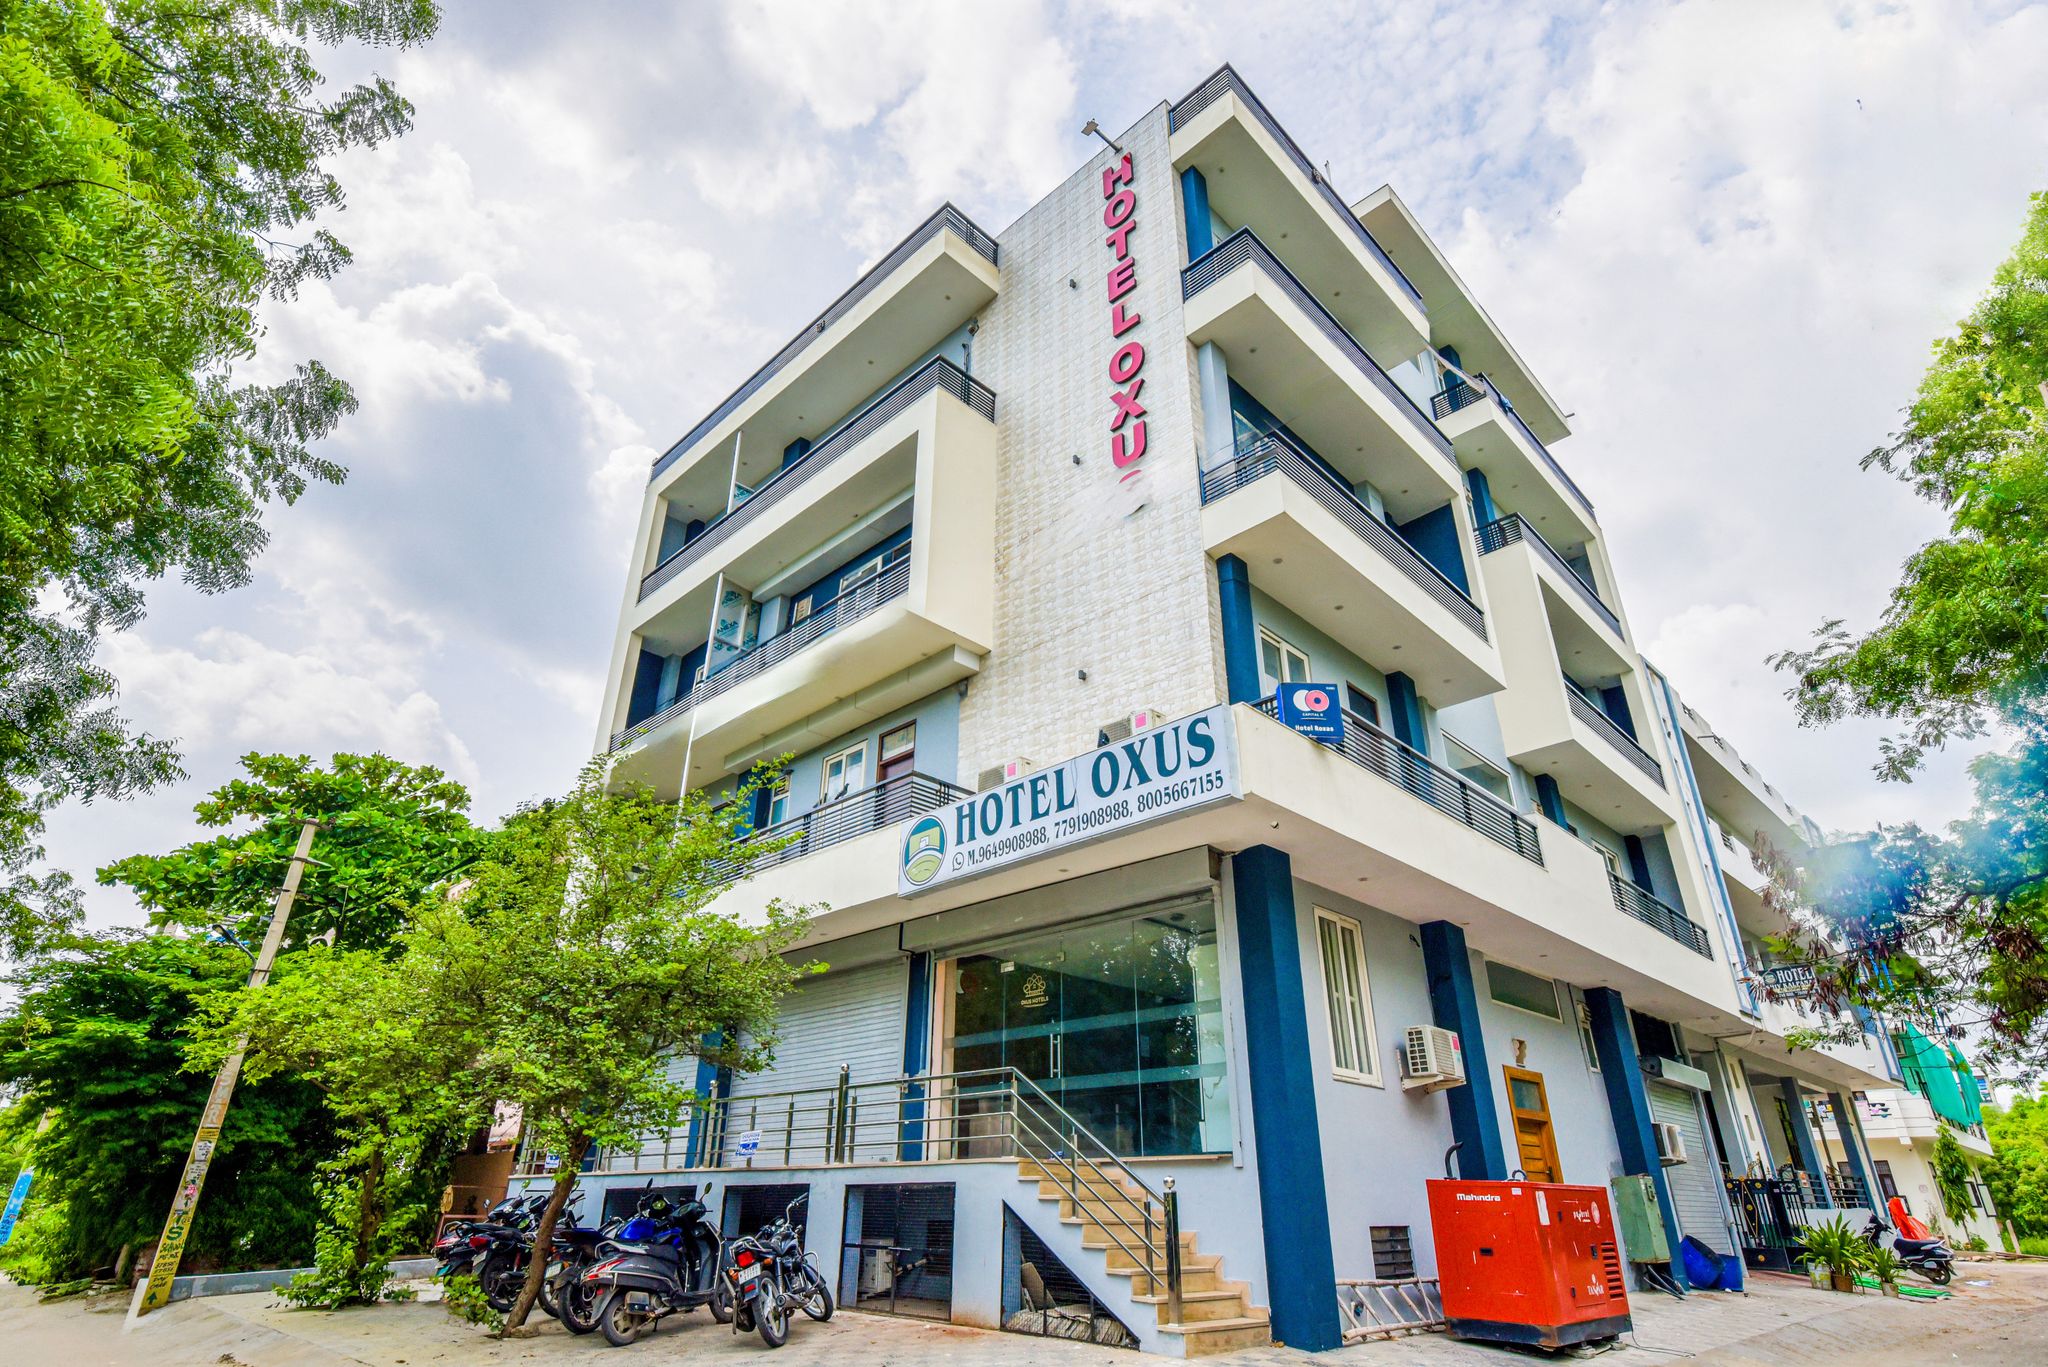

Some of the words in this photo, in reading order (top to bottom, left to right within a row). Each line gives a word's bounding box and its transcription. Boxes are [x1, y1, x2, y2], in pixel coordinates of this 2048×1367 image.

[1103, 152, 1141, 338] HOTEL
[955, 768, 1077, 847] HOTEL
[1091, 716, 1216, 798] OXUS
[1137, 770, 1224, 813] 8005667155
[1776, 967, 1813, 983] HOTEL
